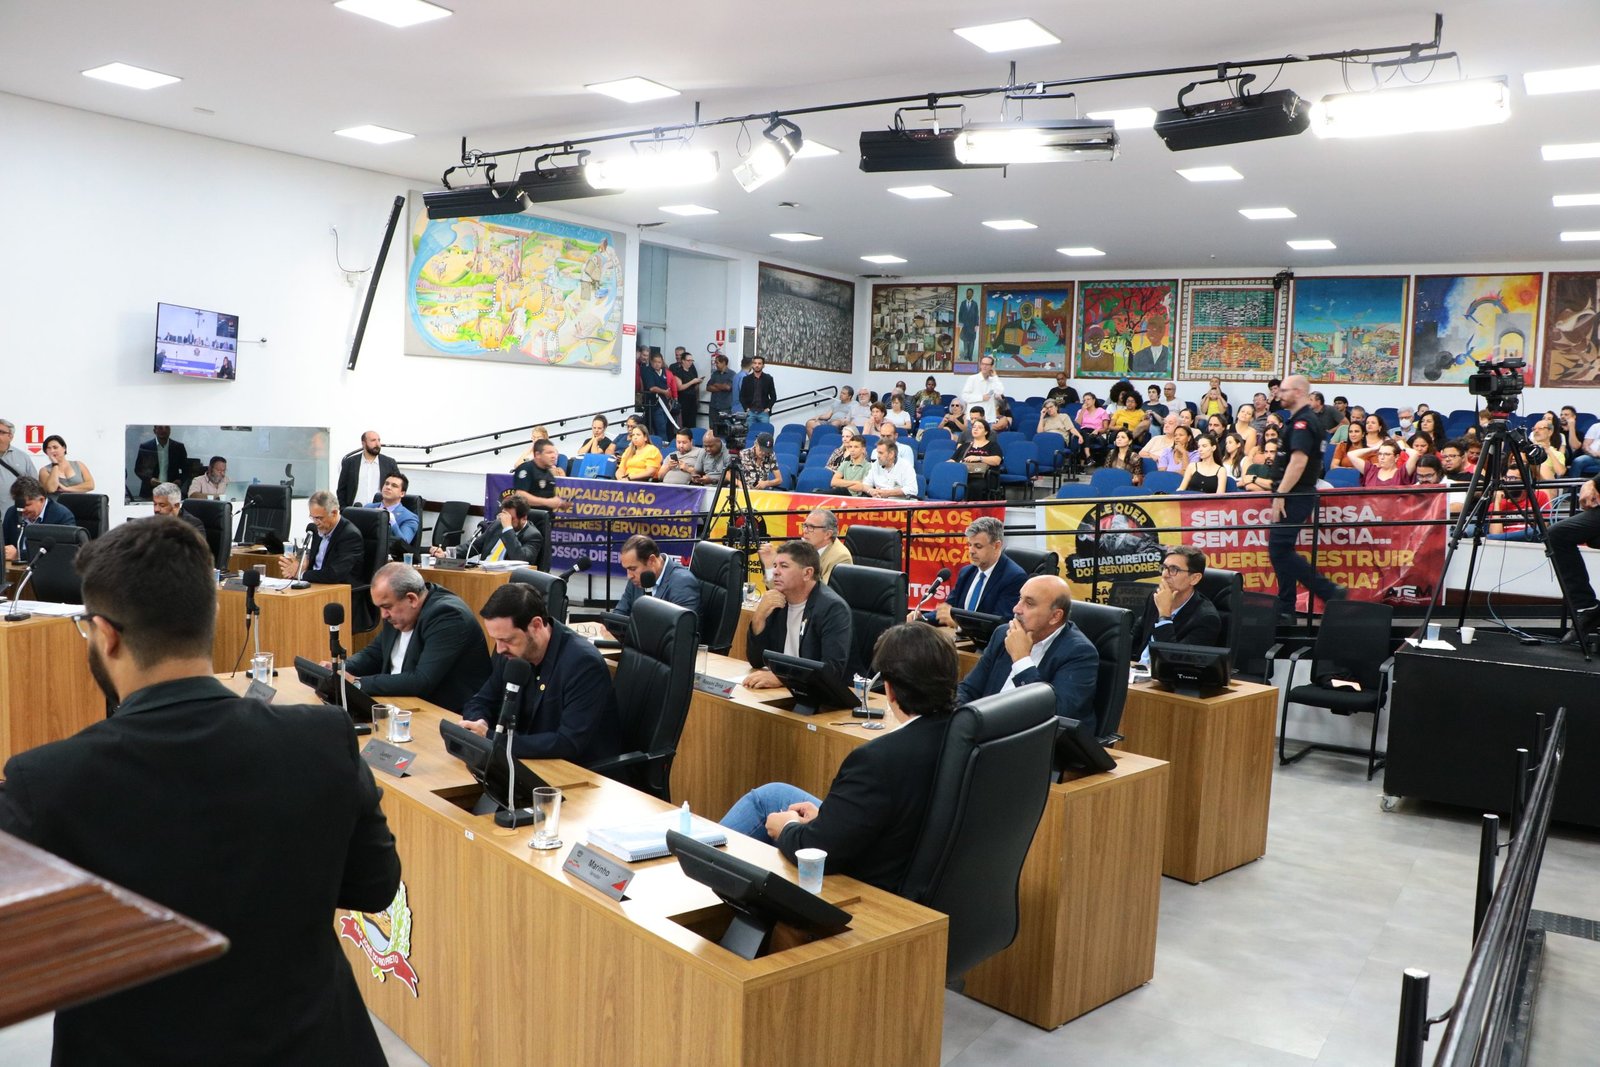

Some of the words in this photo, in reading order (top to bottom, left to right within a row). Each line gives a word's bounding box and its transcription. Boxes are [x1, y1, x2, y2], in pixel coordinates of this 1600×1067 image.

[553, 487, 624, 503] NDICALISTA
[626, 489, 656, 505] NÃO
[575, 503, 616, 516] VOTAR
[617, 506, 671, 521] CONTRA
[674, 509, 693, 522] AS
[946, 510, 973, 526] OS
[1115, 503, 1148, 526] QUER
[1191, 509, 1238, 527] SEM
[1242, 505, 1382, 526] COERSA.
[551, 531, 593, 543] EFENDA
[1191, 531, 1239, 548] SEM
[551, 546, 587, 559] OSSOS
[902, 546, 973, 566] ALVAÇÃ
[1115, 551, 1162, 565] DIREITOS
[1205, 551, 1273, 568] UERE
[1099, 562, 1161, 575] SERVIDORES
[588, 859, 611, 877] Marinho
